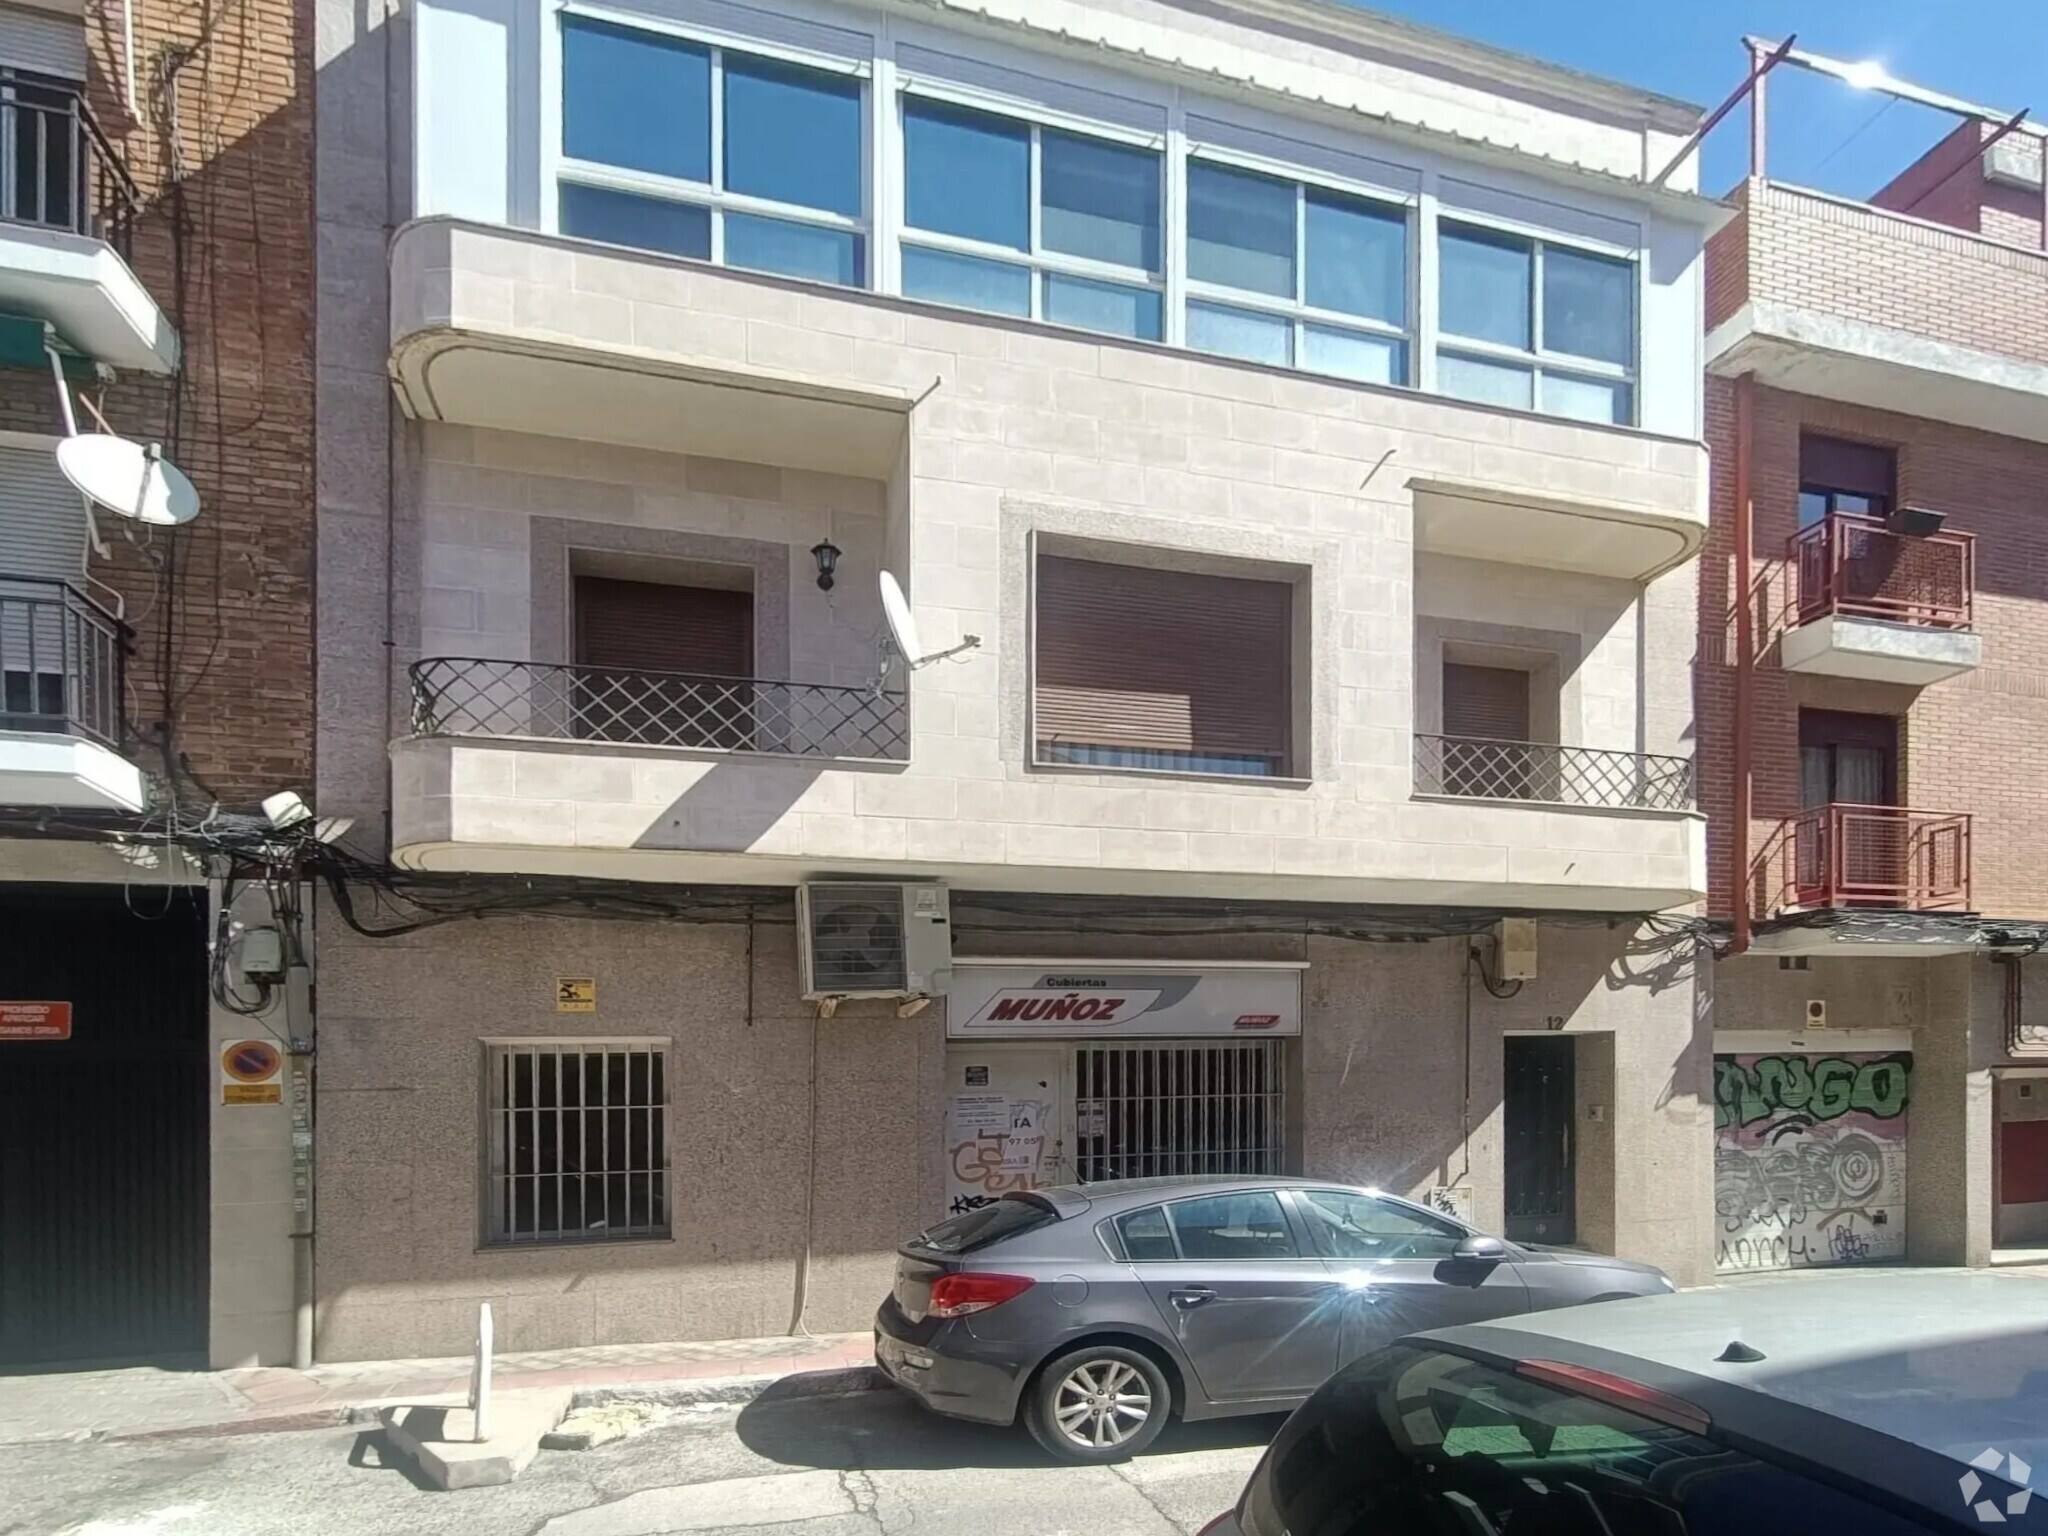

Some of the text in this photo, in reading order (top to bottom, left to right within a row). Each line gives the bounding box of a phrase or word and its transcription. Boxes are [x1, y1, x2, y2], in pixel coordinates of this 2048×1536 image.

[1046, 978, 1107, 987] Cubiertas
[987, 992, 1126, 1021] MUÑOZ
[1547, 1015, 1563, 1031] 12
